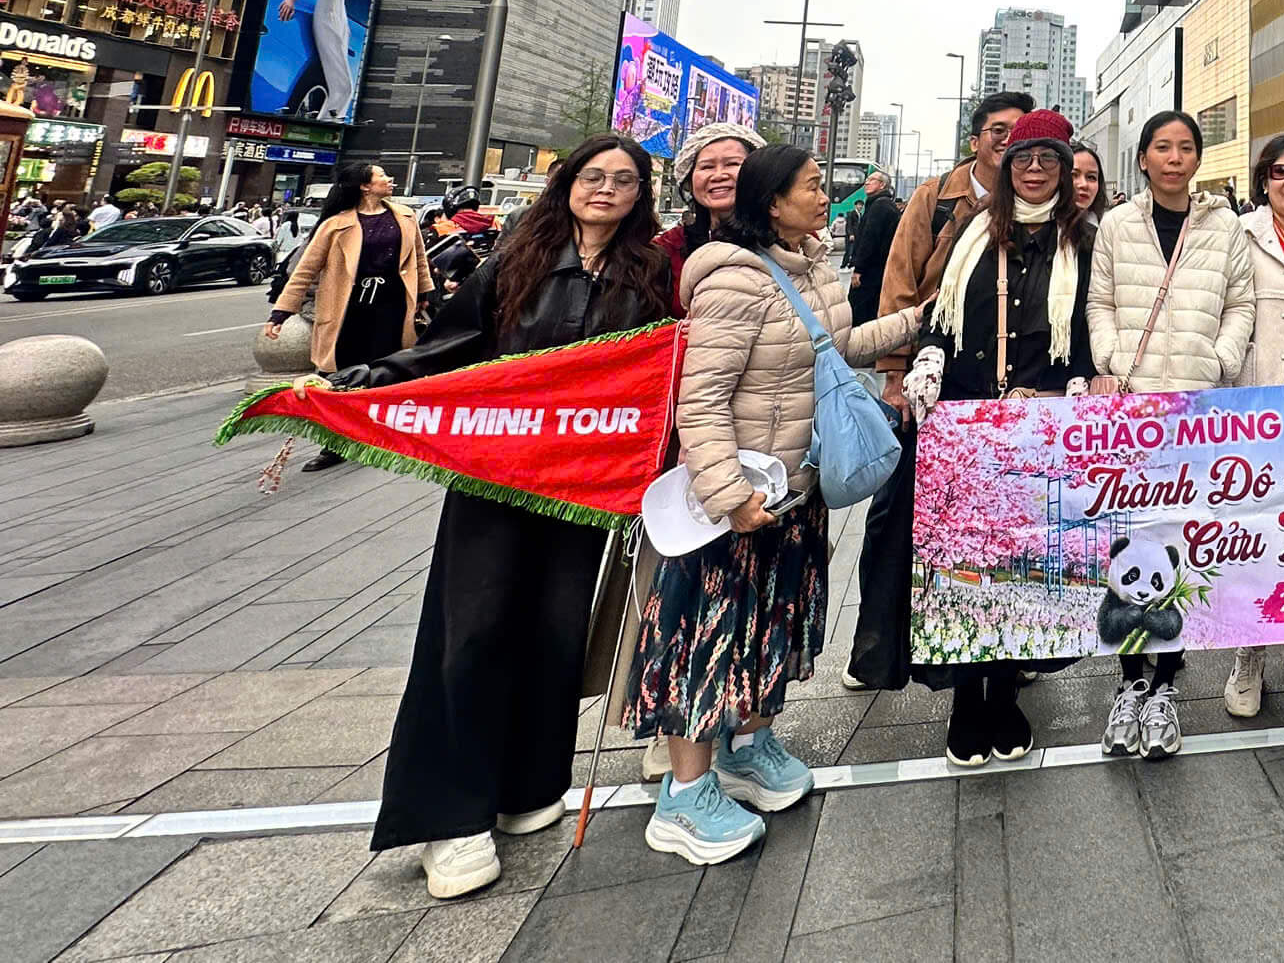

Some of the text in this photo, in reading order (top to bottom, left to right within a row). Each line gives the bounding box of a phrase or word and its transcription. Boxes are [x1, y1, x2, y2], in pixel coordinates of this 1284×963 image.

[368, 399, 641, 435] LIÊN MINH TOUR
[1062, 414, 1165, 453] CHÀO
[1176, 402, 1282, 446] MỪNG
[1084, 463, 1198, 518] Thành
[1183, 520, 1266, 568] Cửu
